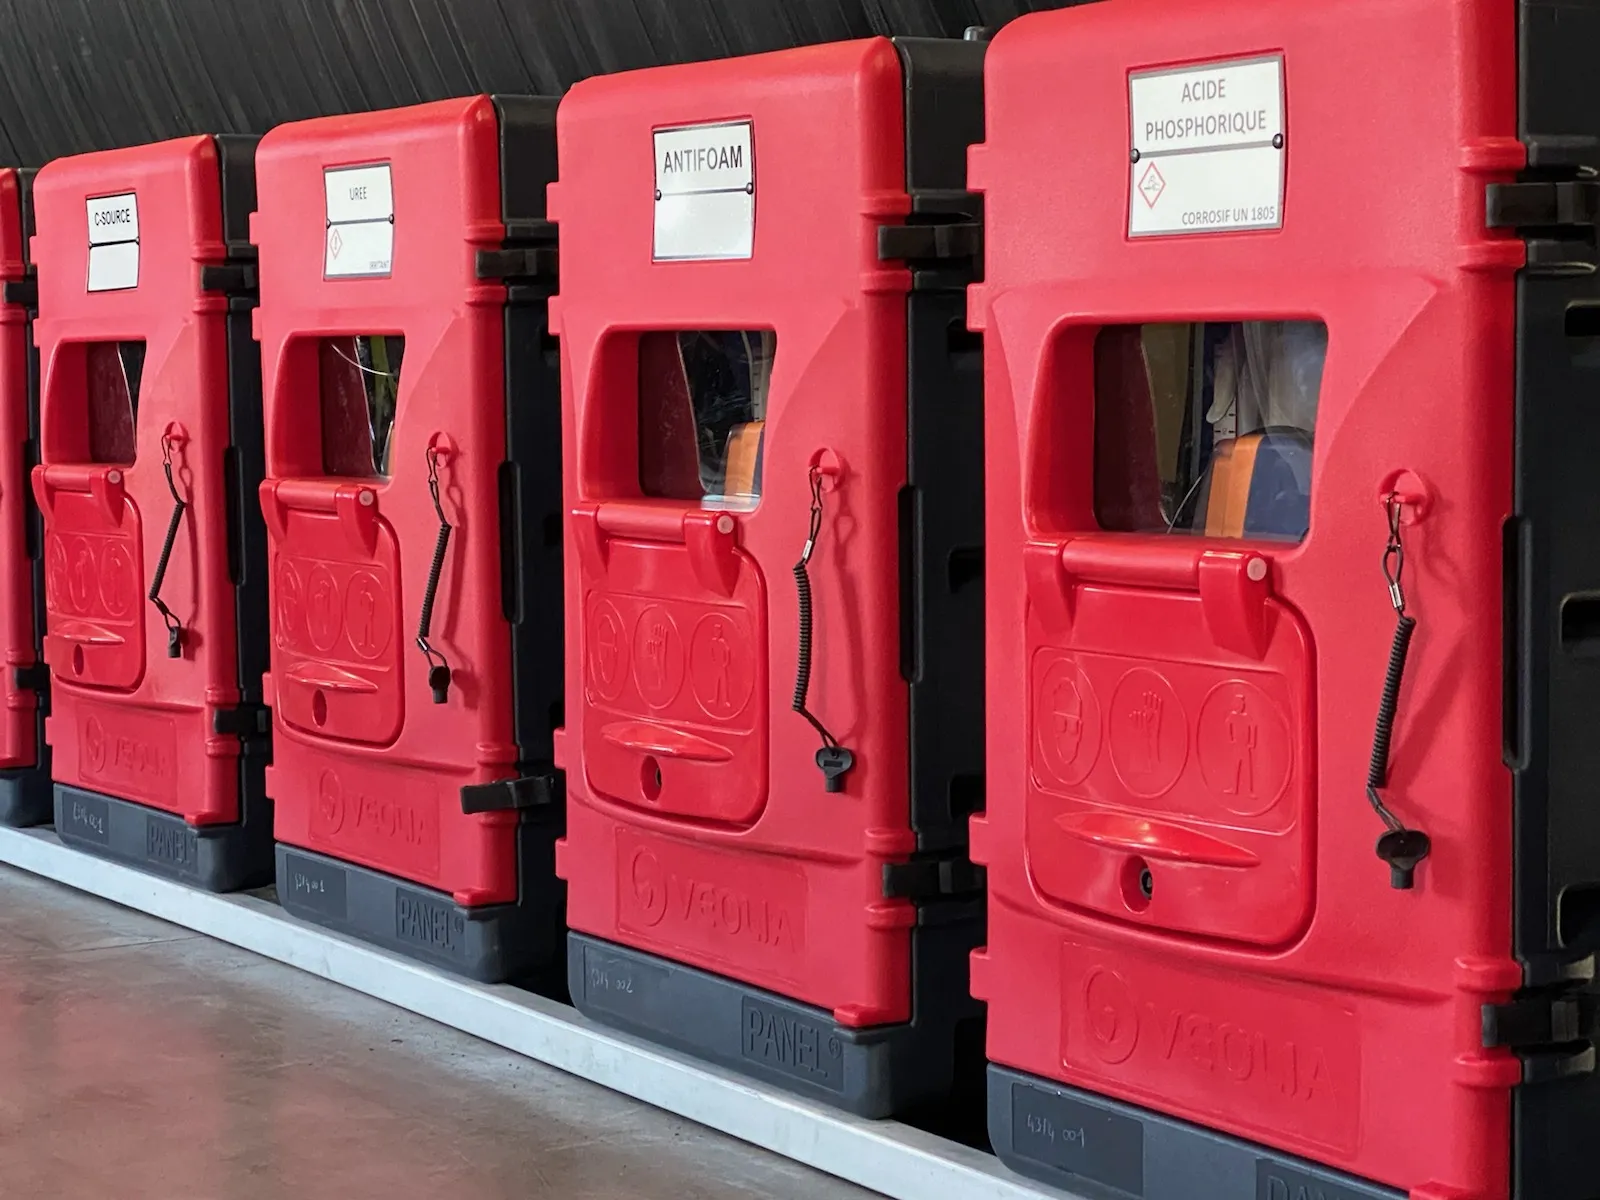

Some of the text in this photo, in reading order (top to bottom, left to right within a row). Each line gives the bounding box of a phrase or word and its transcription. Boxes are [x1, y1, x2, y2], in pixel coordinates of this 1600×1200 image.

[1181, 78, 1226, 103] ACIDE
[1145, 109, 1267, 142] PHOSPHORIQUE
[663, 145, 743, 174] ANTIFOAM
[349, 186, 367, 201] UREE
[94, 208, 131, 226] C-SOURCE
[1181, 206, 1275, 225] CORROSIF UN 1805
[670, 873, 797, 955] VEOLIA
[1145, 1001, 1338, 1112] VEOLIA
